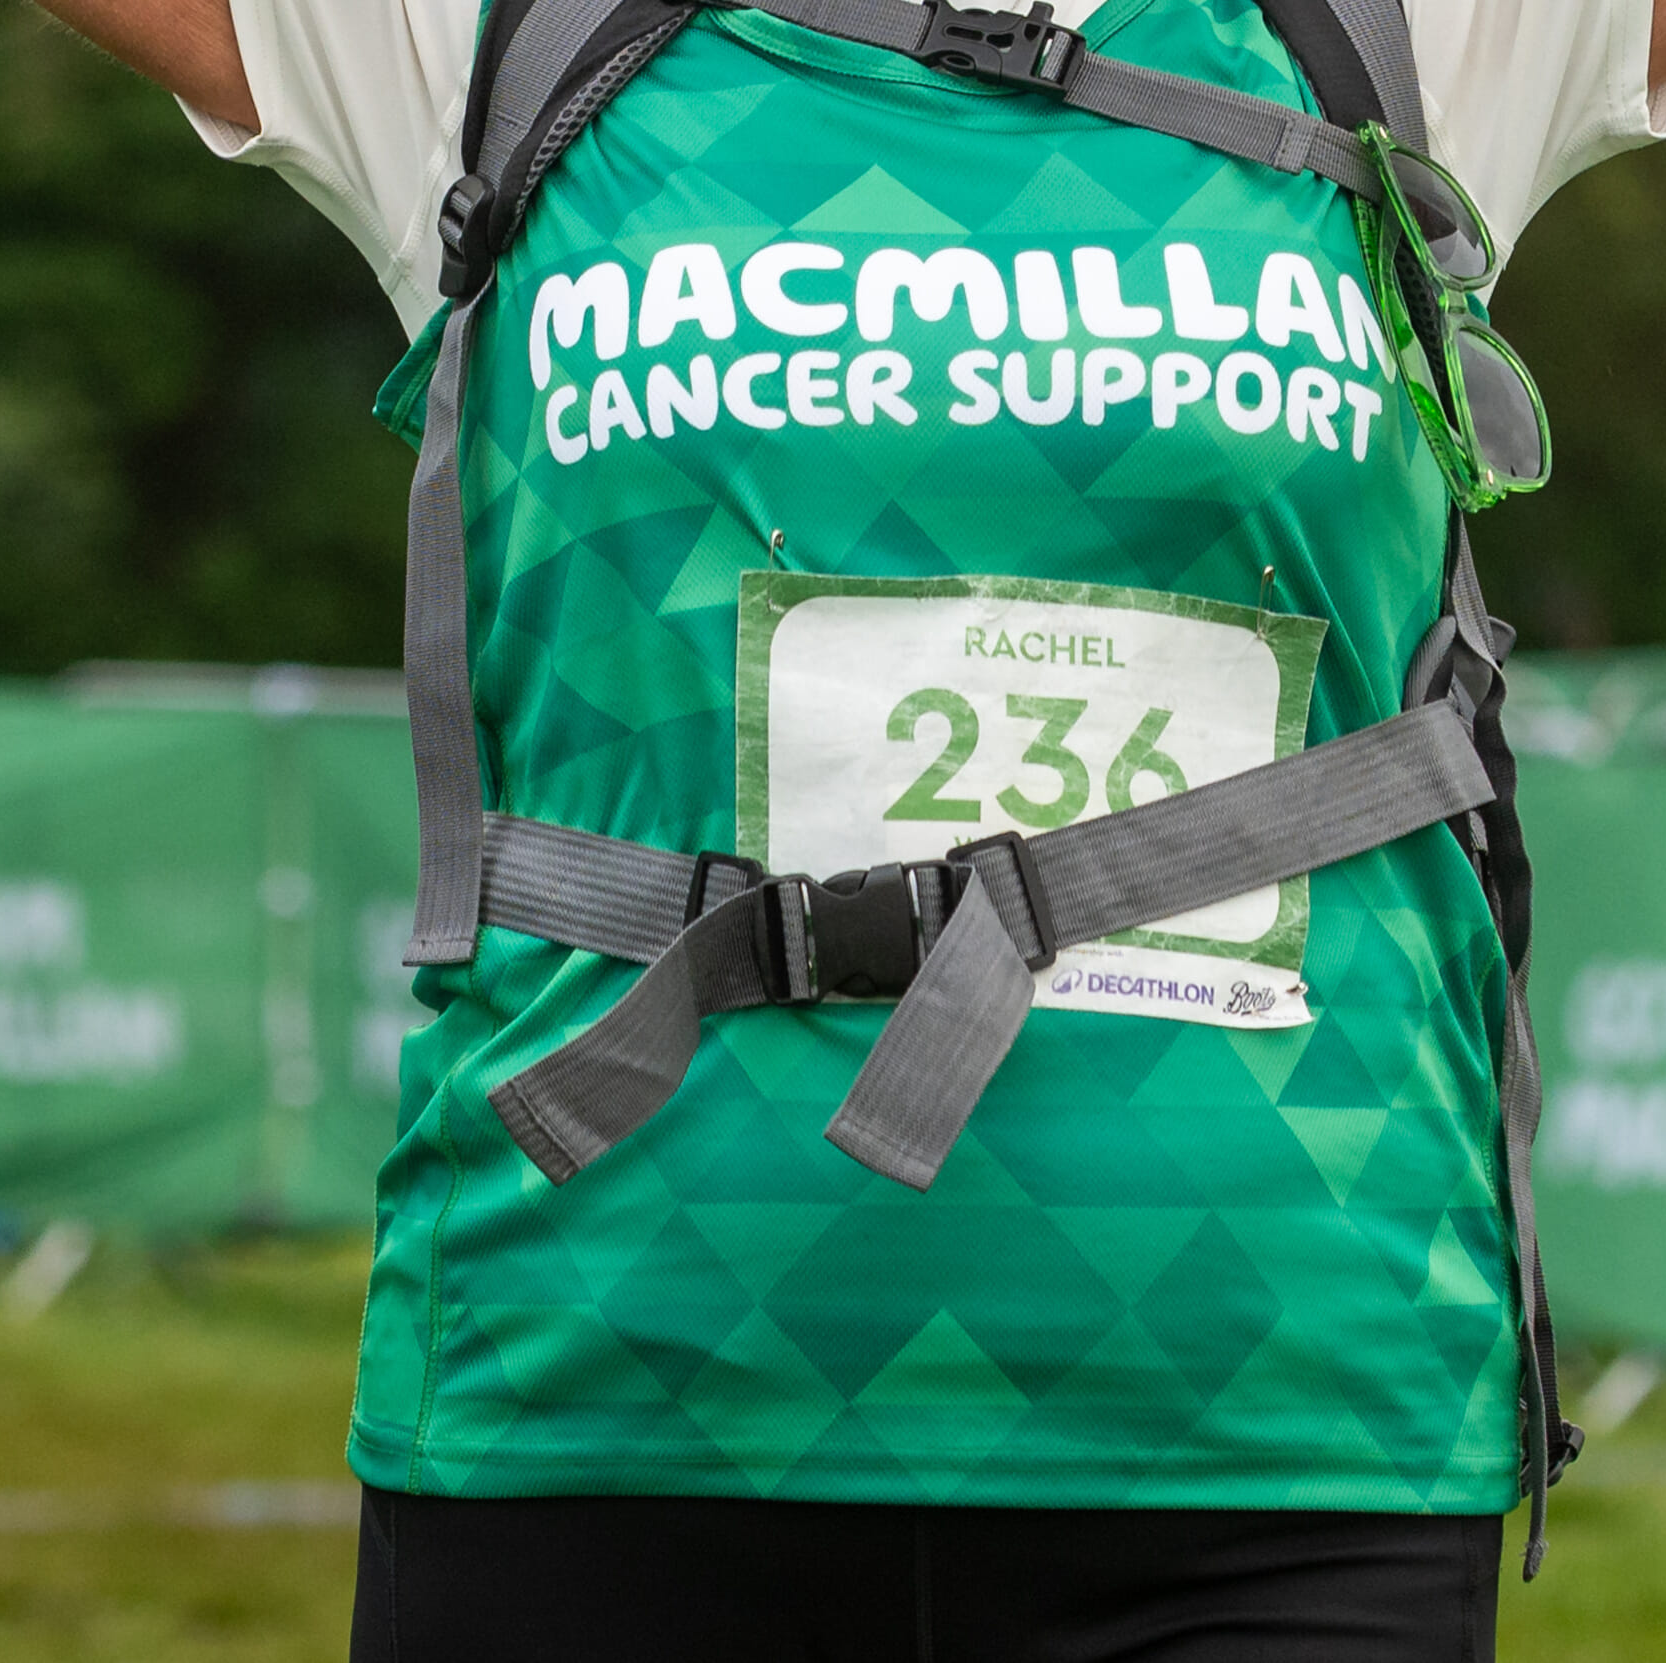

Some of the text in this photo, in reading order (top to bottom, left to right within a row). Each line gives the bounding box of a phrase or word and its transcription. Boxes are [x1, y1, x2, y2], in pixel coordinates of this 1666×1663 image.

[530, 241, 1397, 391] MACMILLAN
[544, 347, 1383, 465] CANCER SUPPORT
[963, 625, 1126, 670] RACHEL
[883, 687, 1189, 831] 236
[1088, 973, 1276, 1016] DECATHLON Boots
